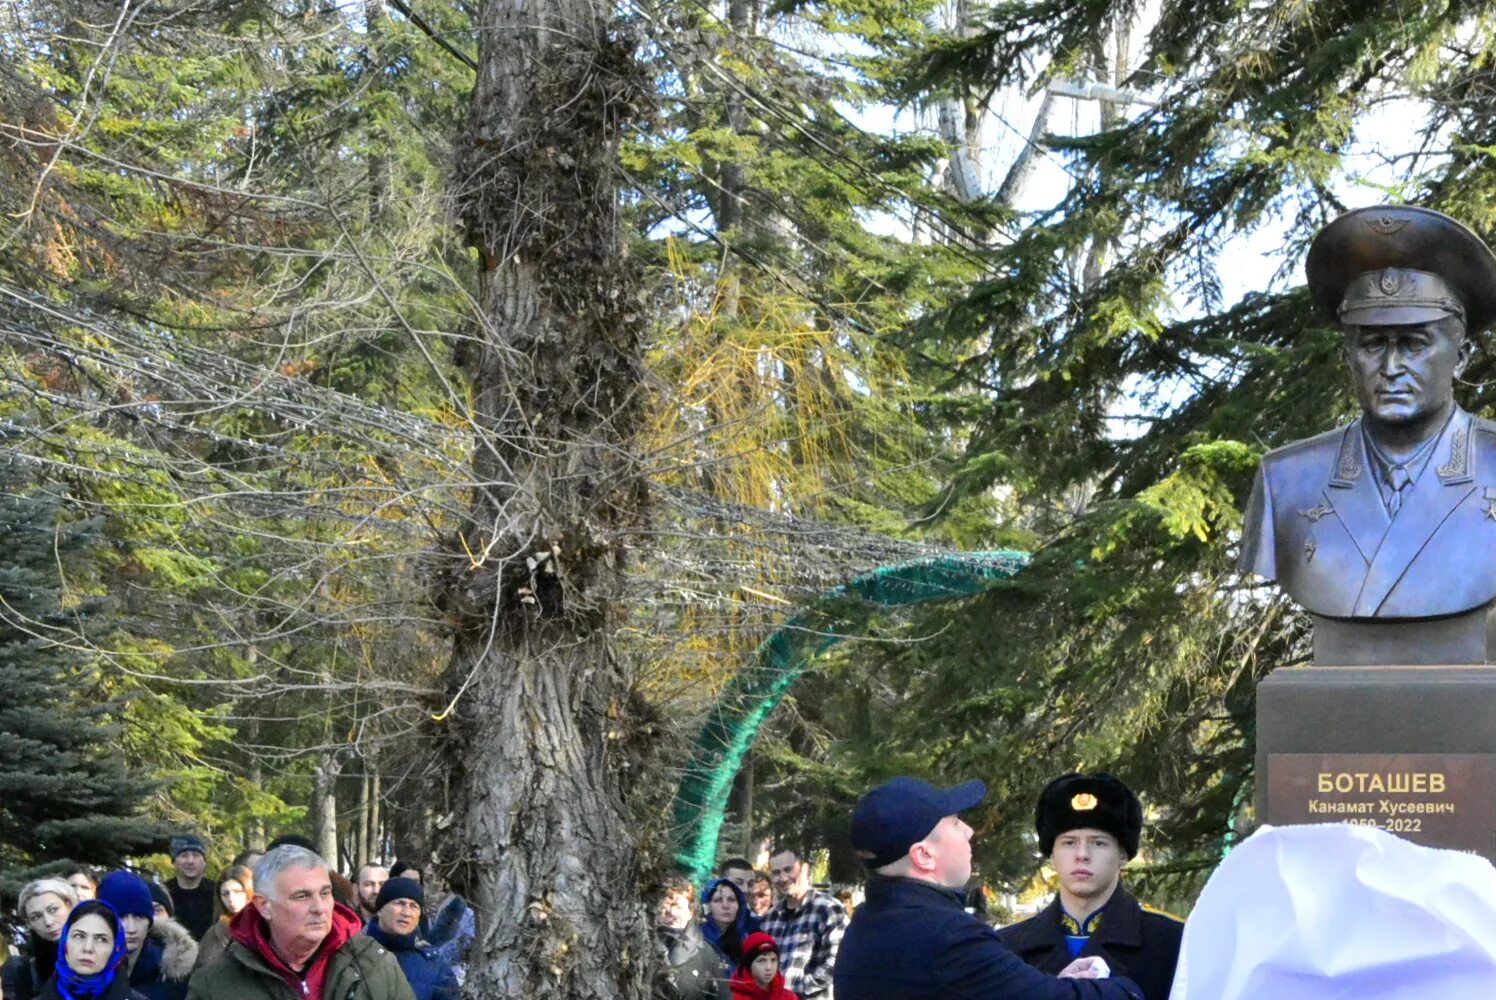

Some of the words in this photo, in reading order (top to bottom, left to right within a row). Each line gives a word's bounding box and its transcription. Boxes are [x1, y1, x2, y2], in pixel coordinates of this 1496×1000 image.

[1317, 773, 1446, 793] БОТАШЕВ
[1308, 800, 1374, 814] Канамат
[1379, 799, 1455, 817] Хусеевич
